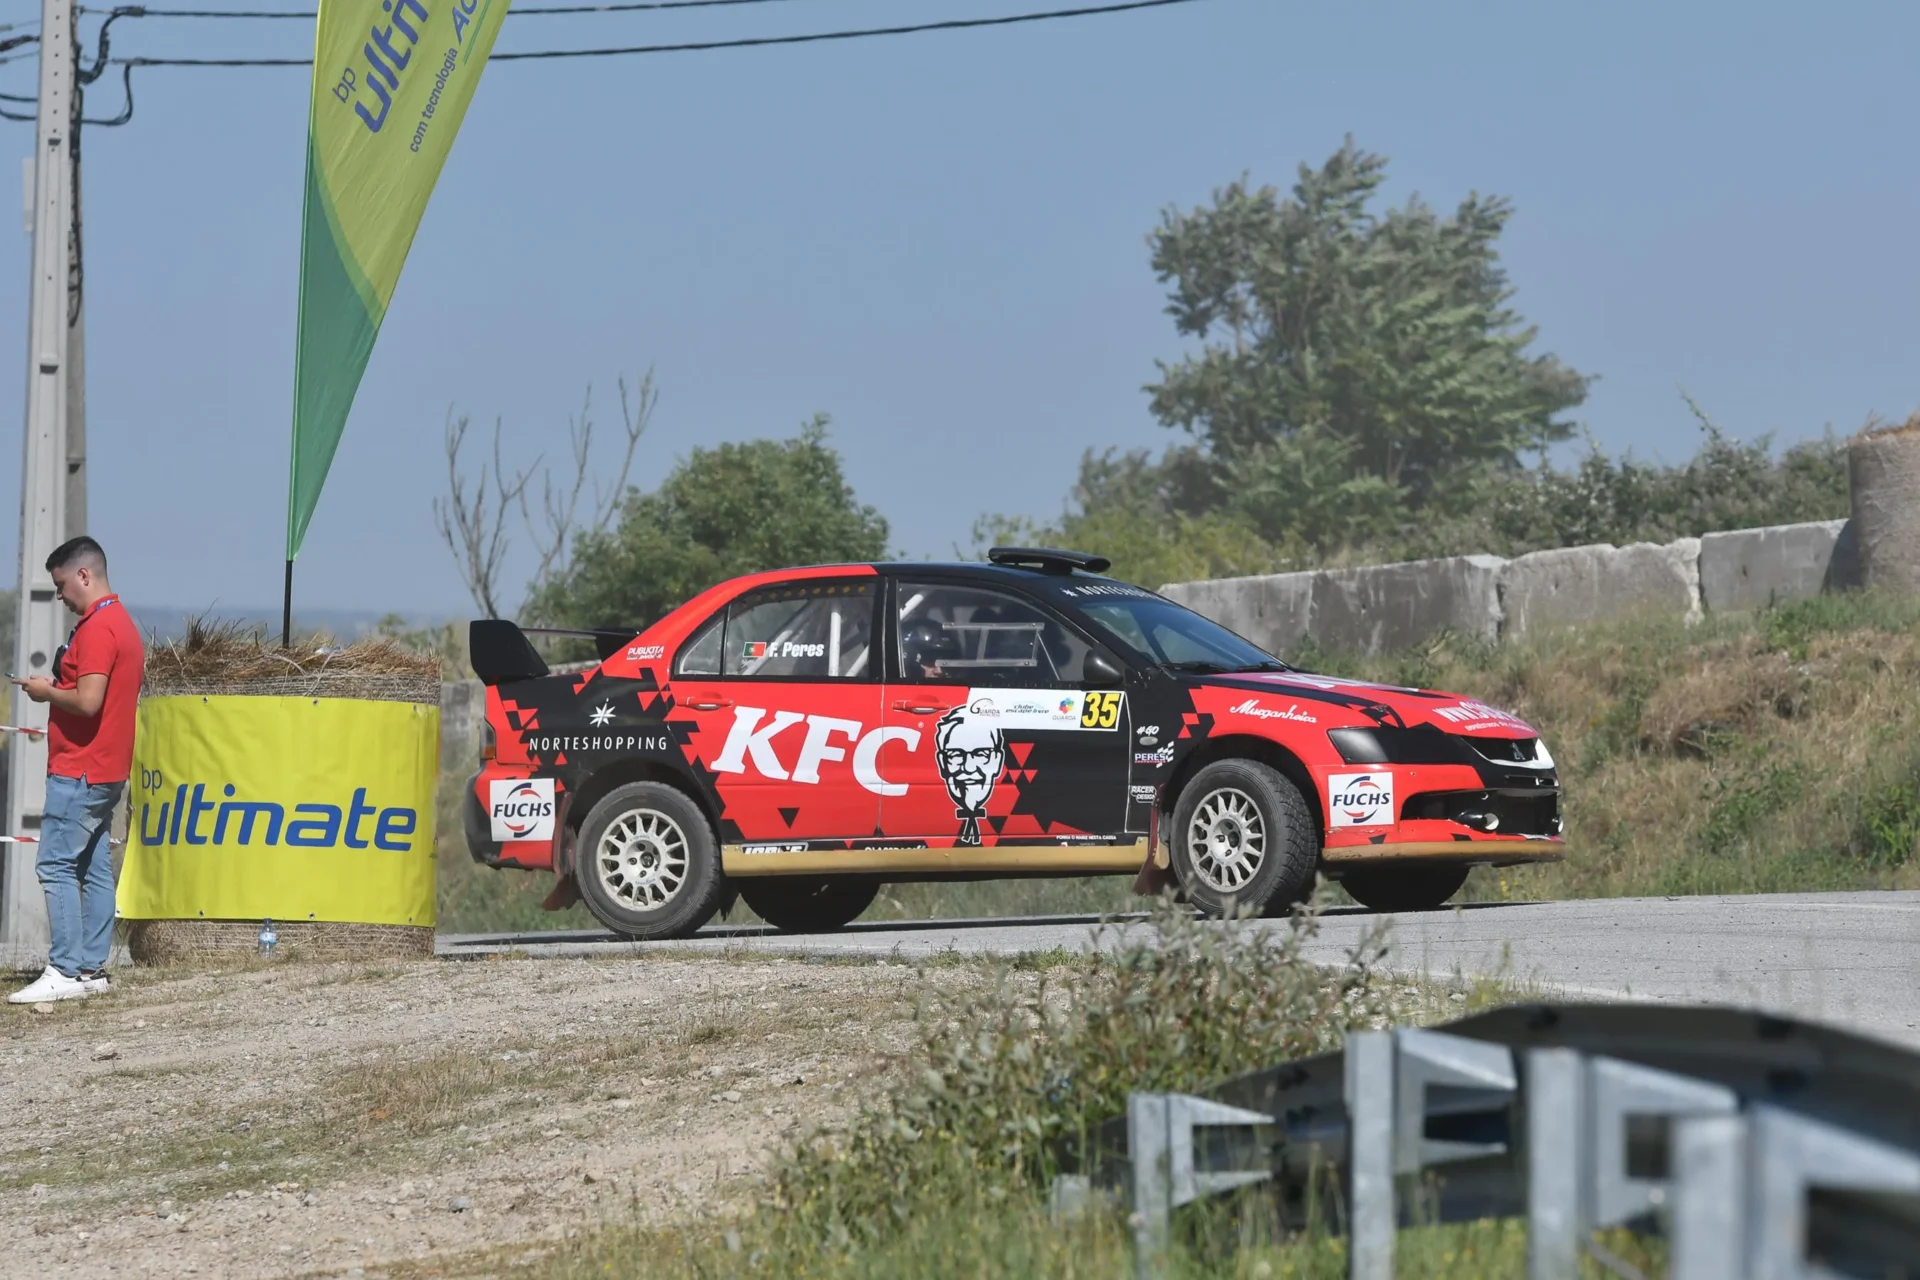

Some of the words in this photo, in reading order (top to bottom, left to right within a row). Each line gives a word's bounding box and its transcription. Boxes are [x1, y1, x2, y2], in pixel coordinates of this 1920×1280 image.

[332, 67, 356, 104] bp
[410, 121, 428, 153] com
[421, 48, 458, 120] tecnologia
[768, 642, 778, 658] F.
[782, 641, 824, 658] Peres
[1081, 692, 1120, 728] 35
[529, 736, 667, 751] NORTESHOPPING
[710, 706, 922, 797] KFC
[1134, 753, 1166, 761] PERES
[141, 763, 163, 796] bp
[493, 802, 552, 818] FUCHS
[1332, 792, 1391, 807] FUCHS
[140, 783, 416, 851] ultimate
